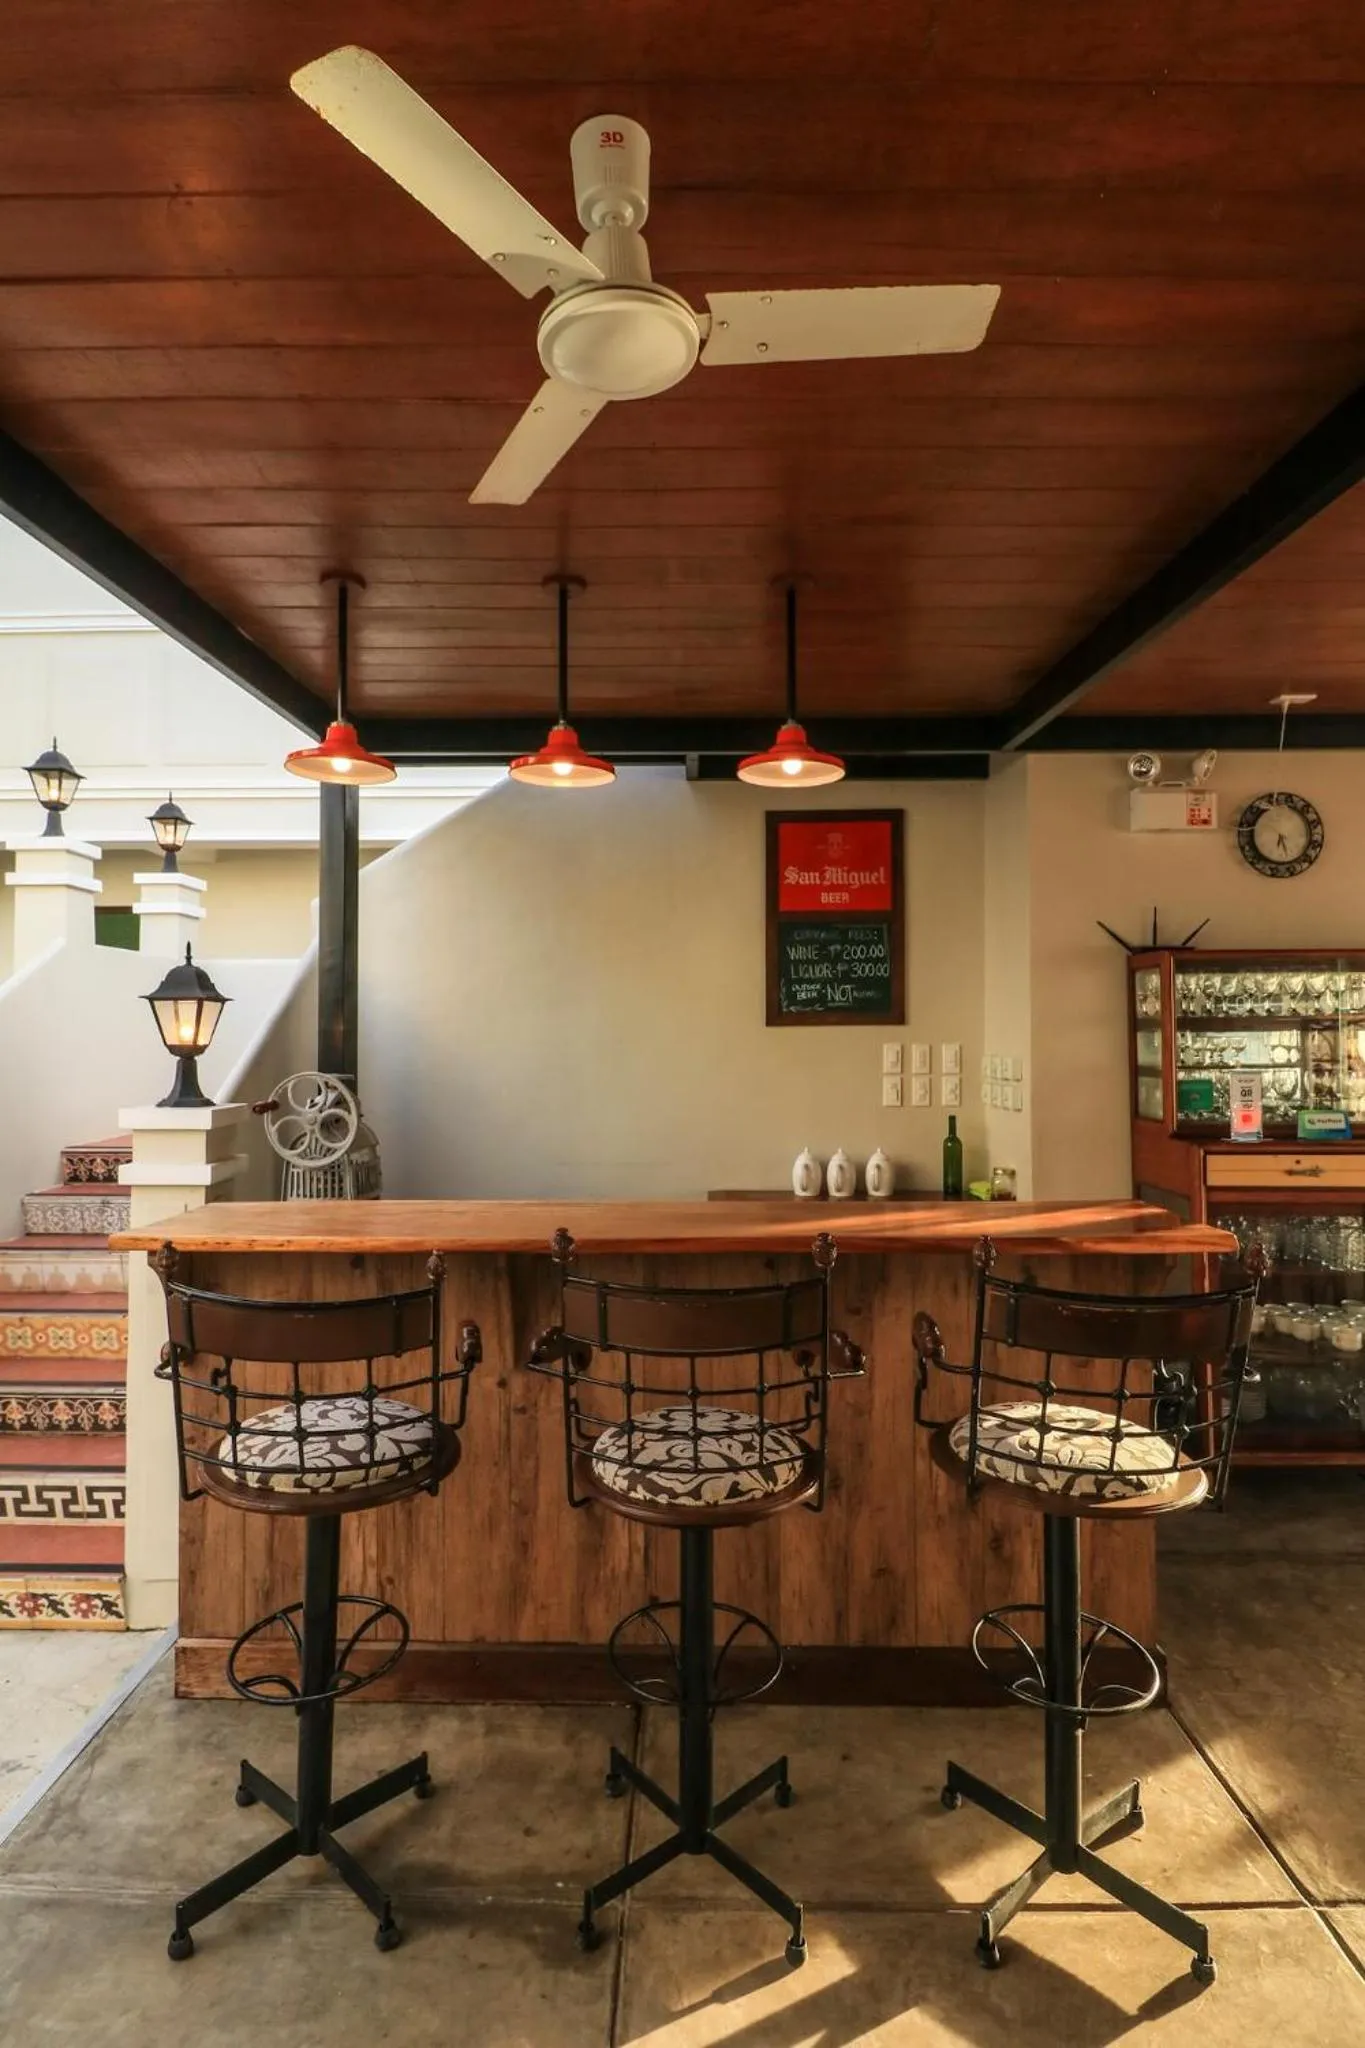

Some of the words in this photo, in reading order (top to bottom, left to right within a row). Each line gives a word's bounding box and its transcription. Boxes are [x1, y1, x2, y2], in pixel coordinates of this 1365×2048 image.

[601, 131, 624, 143] 3D
[783, 865, 820, 885] San
[821, 865, 888, 889] Miguel
[820, 891, 850, 904] BEER
[827, 982, 856, 1004] NOT
